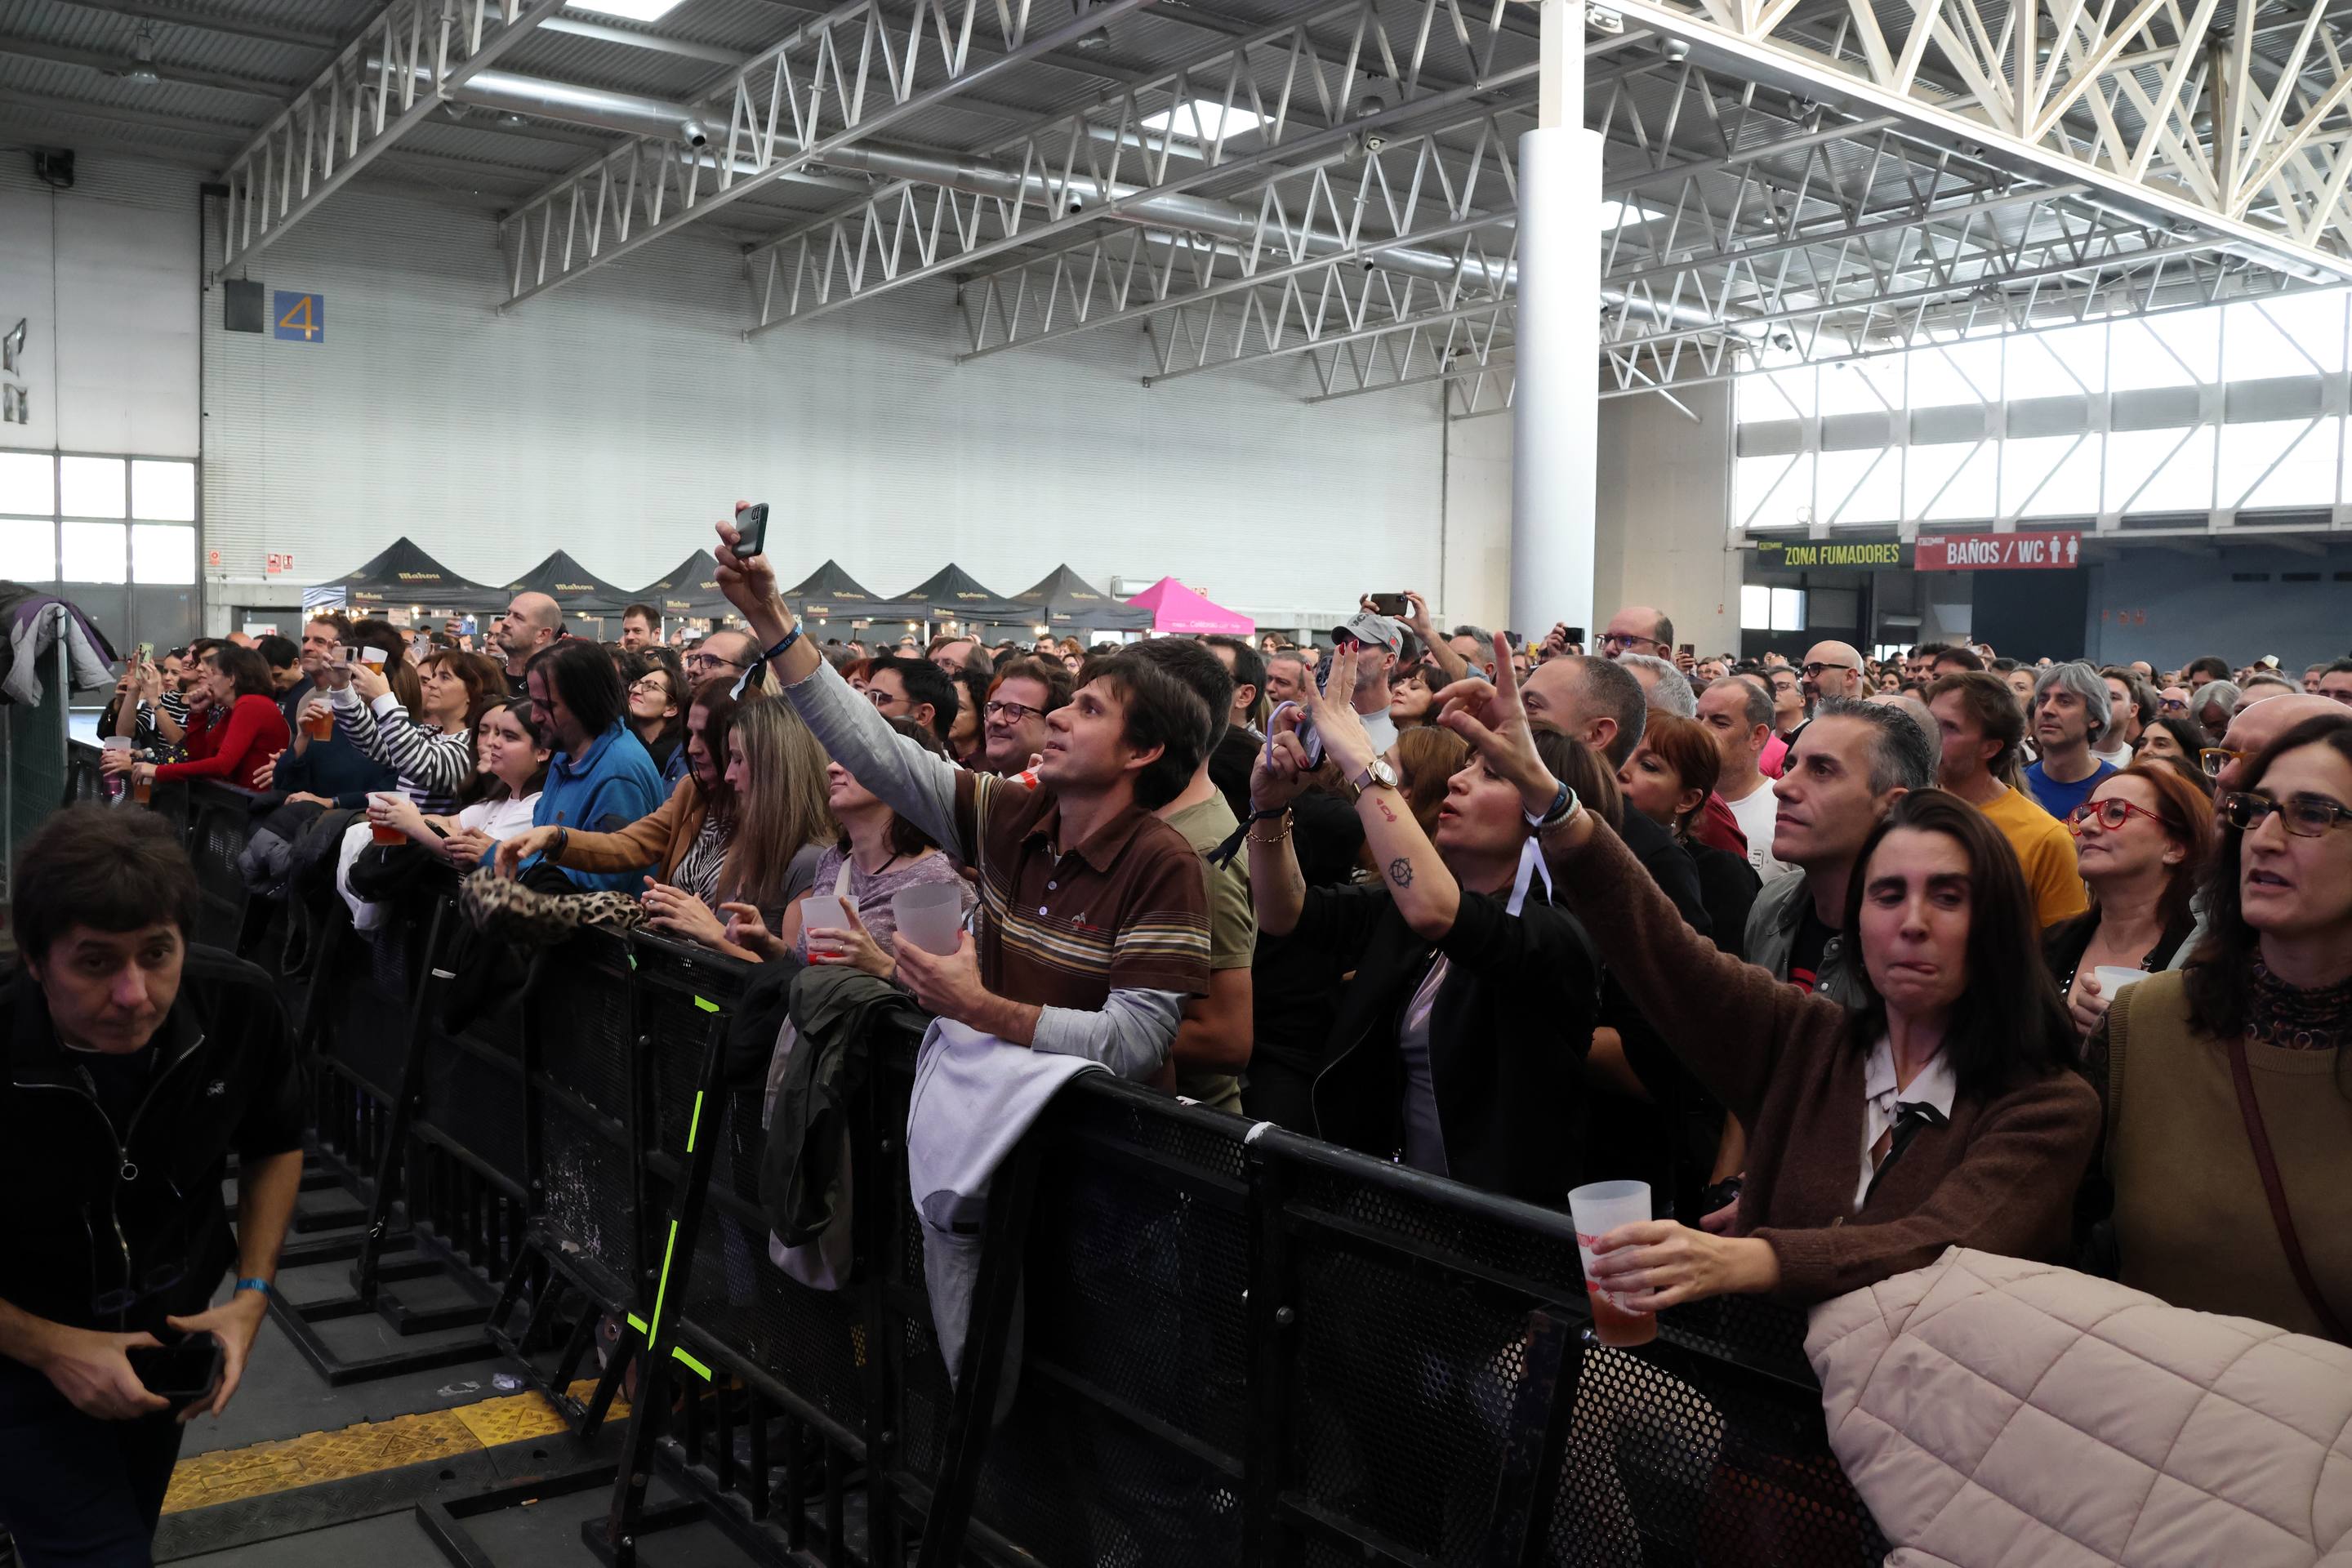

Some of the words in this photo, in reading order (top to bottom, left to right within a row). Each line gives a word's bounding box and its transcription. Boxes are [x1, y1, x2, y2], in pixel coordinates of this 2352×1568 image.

[279, 296, 319, 340] 4
[1785, 546, 1817, 565] ZONA
[1821, 543, 1900, 564] FUMADORES
[1947, 538, 2000, 564] BAÑOS
[2003, 540, 2015, 563] /
[2018, 540, 2045, 564] WC
